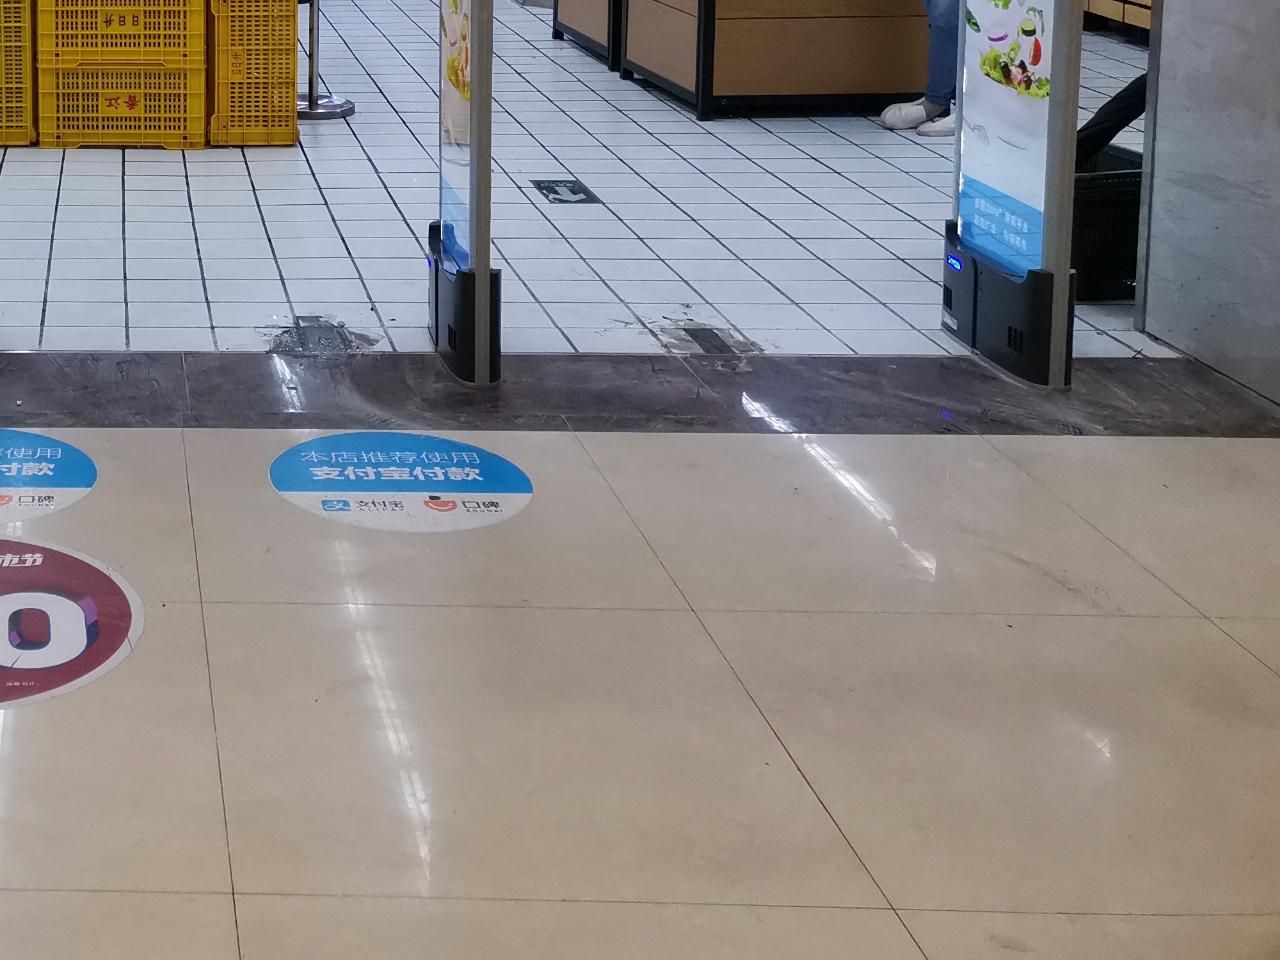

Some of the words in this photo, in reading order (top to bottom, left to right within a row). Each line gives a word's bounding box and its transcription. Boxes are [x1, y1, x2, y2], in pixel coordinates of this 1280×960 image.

[300, 450, 480, 465] 本店推荐使用
[308, 466, 484, 481] 支付宝付款
[354, 500, 405, 509] 支付宝
[462, 500, 502, 509] 口碑
